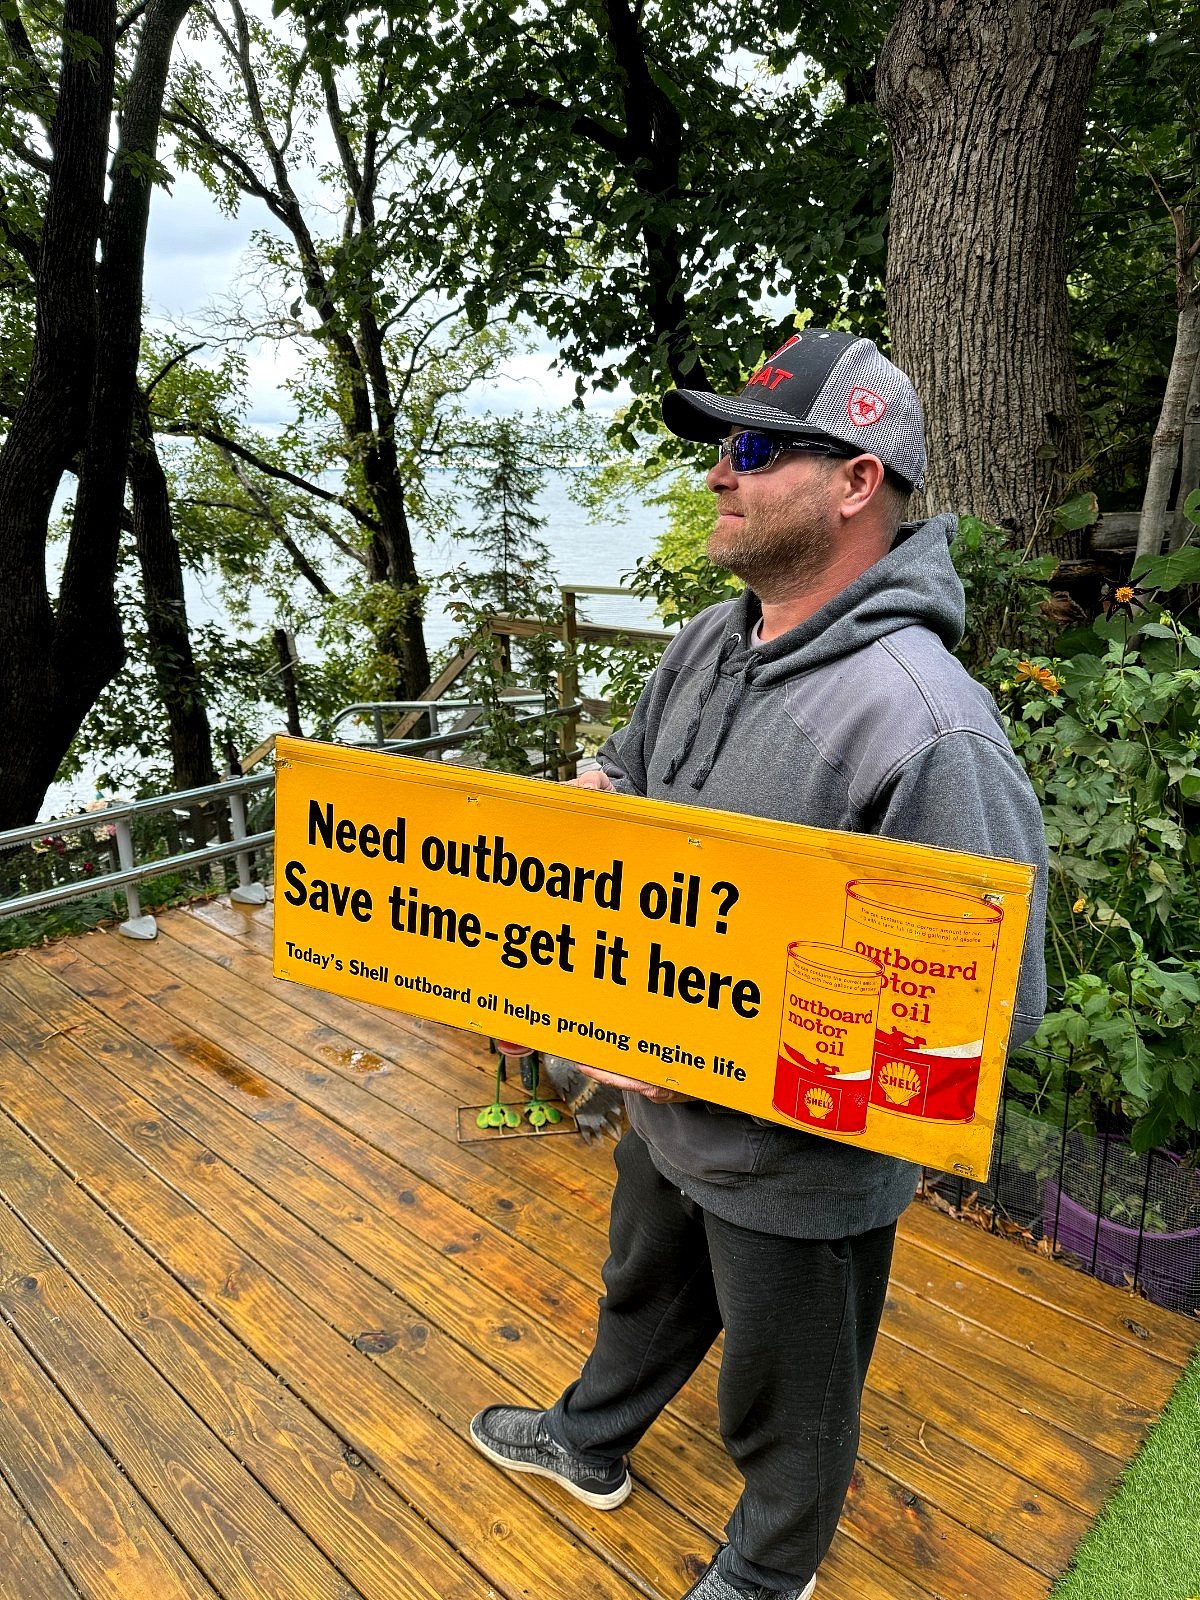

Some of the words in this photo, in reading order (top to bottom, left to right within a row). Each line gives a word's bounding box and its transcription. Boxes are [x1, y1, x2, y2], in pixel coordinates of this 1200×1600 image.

[308, 800, 406, 865] Need
[422, 836, 624, 912] outboard
[640, 871, 740, 935] oil?
[284, 861, 373, 923] Save
[389, 886, 576, 973] time-get
[594, 930, 629, 986] it
[648, 943, 761, 1019] here
[855, 941, 978, 981] outboard
[881, 969, 936, 999] otor
[286, 942, 344, 971] Today's
[349, 960, 389, 983] Shell
[395, 974, 471, 1004] outboard
[478, 995, 498, 1012] oil
[504, 998, 551, 1026] helps
[558, 1018, 630, 1052] prolong
[638, 1040, 706, 1070] engine
[713, 1055, 747, 1082] life
[789, 993, 873, 1025] outboard
[891, 1002, 931, 1024] oil
[788, 1010, 848, 1040] motor
[815, 1040, 845, 1057] oil
[882, 1074, 921, 1092] SHELL
[806, 1096, 834, 1110] SHELL
